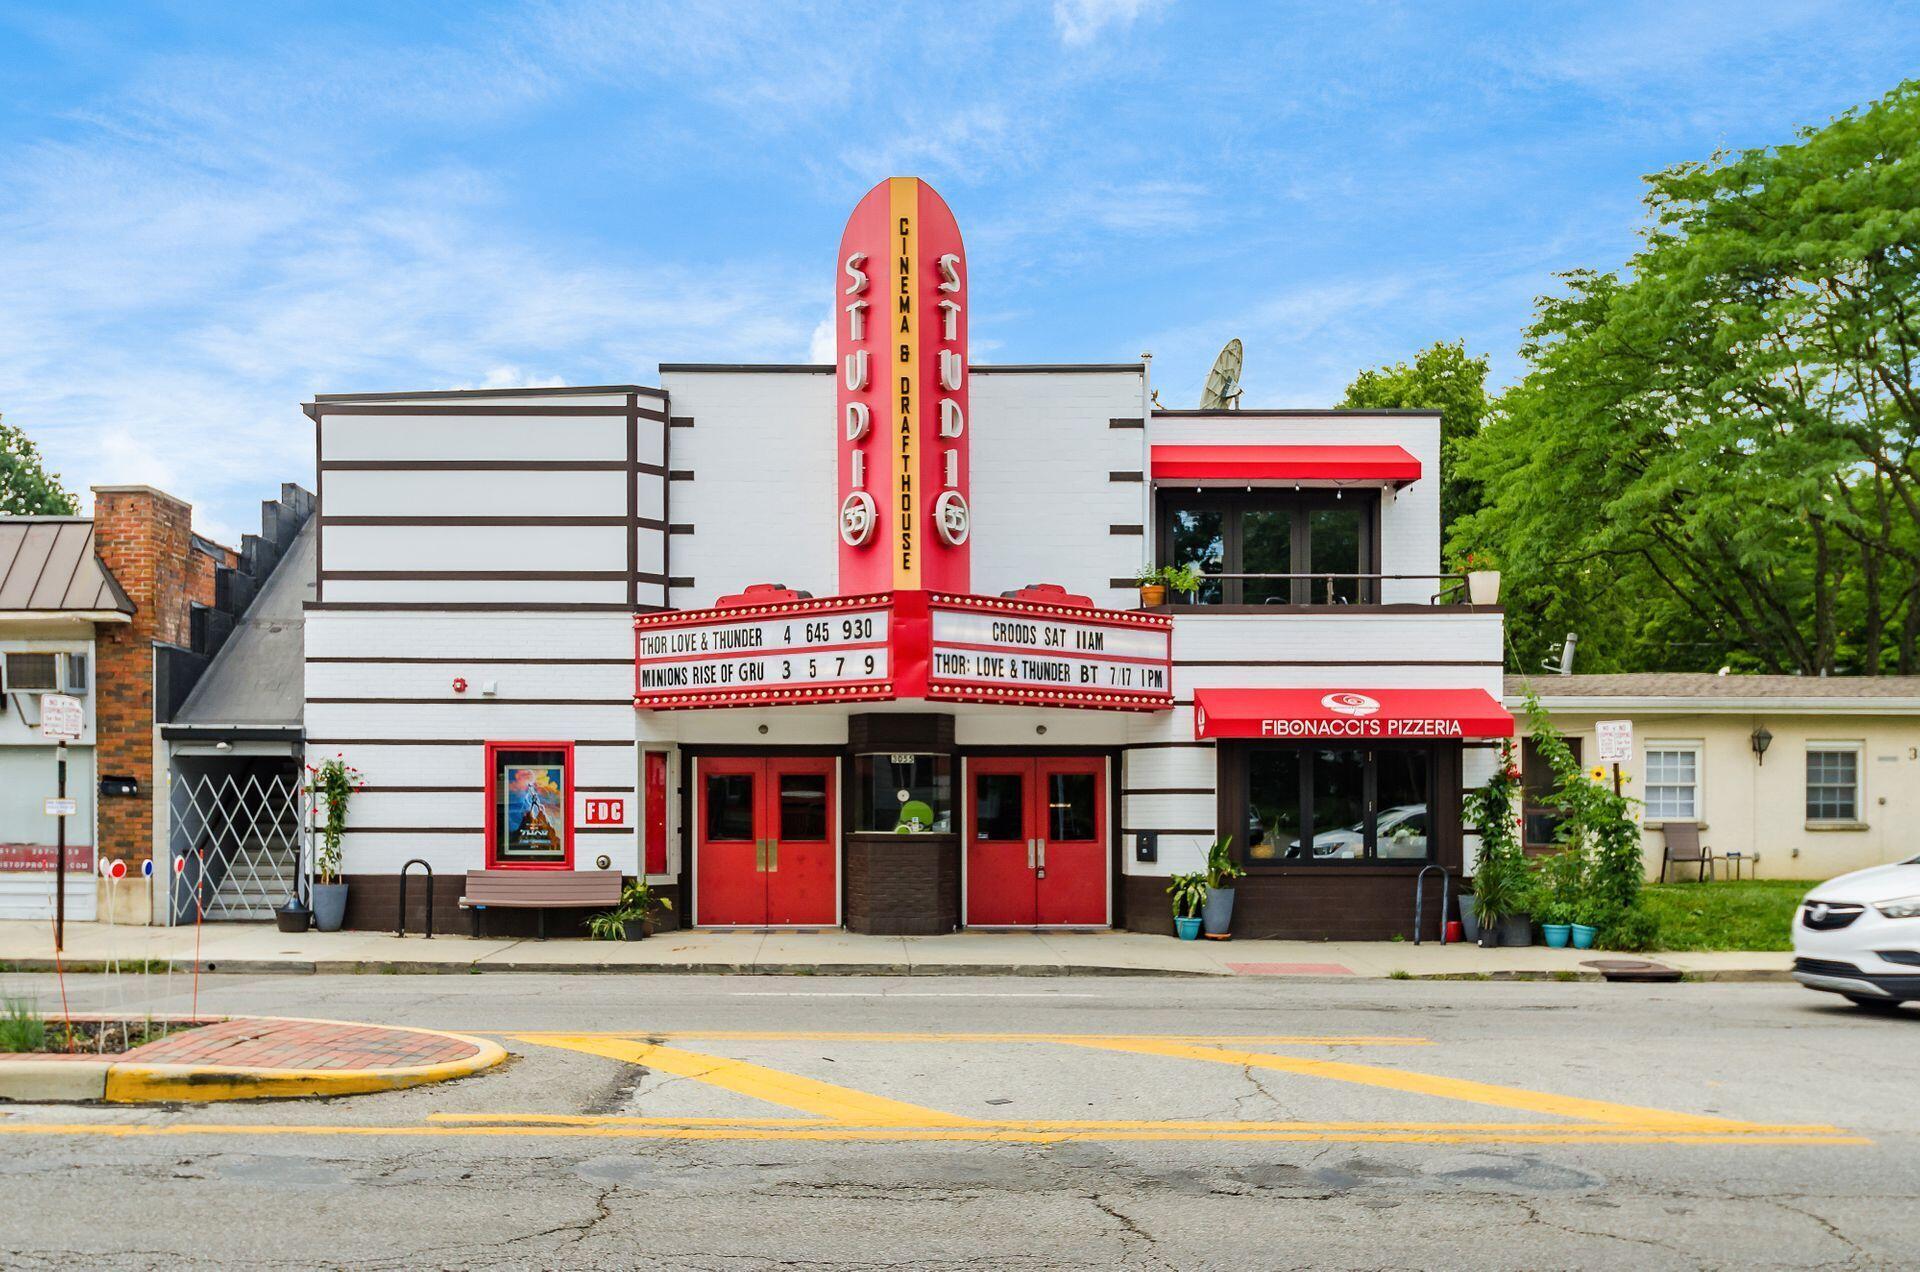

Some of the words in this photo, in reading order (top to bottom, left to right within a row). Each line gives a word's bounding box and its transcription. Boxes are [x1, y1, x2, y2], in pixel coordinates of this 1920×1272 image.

[899, 217, 911, 333] CINEMA
[899, 344, 911, 362] &
[840, 252, 877, 547] STUDIO
[935, 253, 971, 547] STUDIO
[900, 376, 912, 571] DRAFTHOUSE
[844, 503, 867, 532] 35
[945, 503, 967, 532] 35
[640, 636, 668, 655] THOR
[671, 633, 697, 653] LOVE
[700, 632, 709, 651] &
[712, 627, 763, 650] THUNDER
[783, 625, 792, 645] 4
[805, 622, 830, 643] 645
[842, 618, 873, 640] 930
[992, 621, 1037, 645] CROODS
[1044, 626, 1067, 648] SAT
[642, 666, 688, 688] MINIONS
[693, 664, 717, 685] RISE
[720, 663, 734, 683] OF
[738, 662, 764, 682] GRU
[782, 660, 791, 680] 3
[808, 658, 817, 678] 5
[835, 656, 846, 677] 7
[864, 654, 875, 675] 9
[934, 653, 971, 675] THOR:
[976, 656, 1004, 678] LOVE
[1010, 659, 1018, 679] &
[1022, 660, 1071, 683] THUNDER
[1080, 664, 1099, 684] BT
[1110, 666, 1132, 687] 7/17
[1261, 719, 1381, 736] FIBONACCI'S
[1387, 719, 1463, 736] PIZZERIA
[586, 801, 622, 821] FDC
